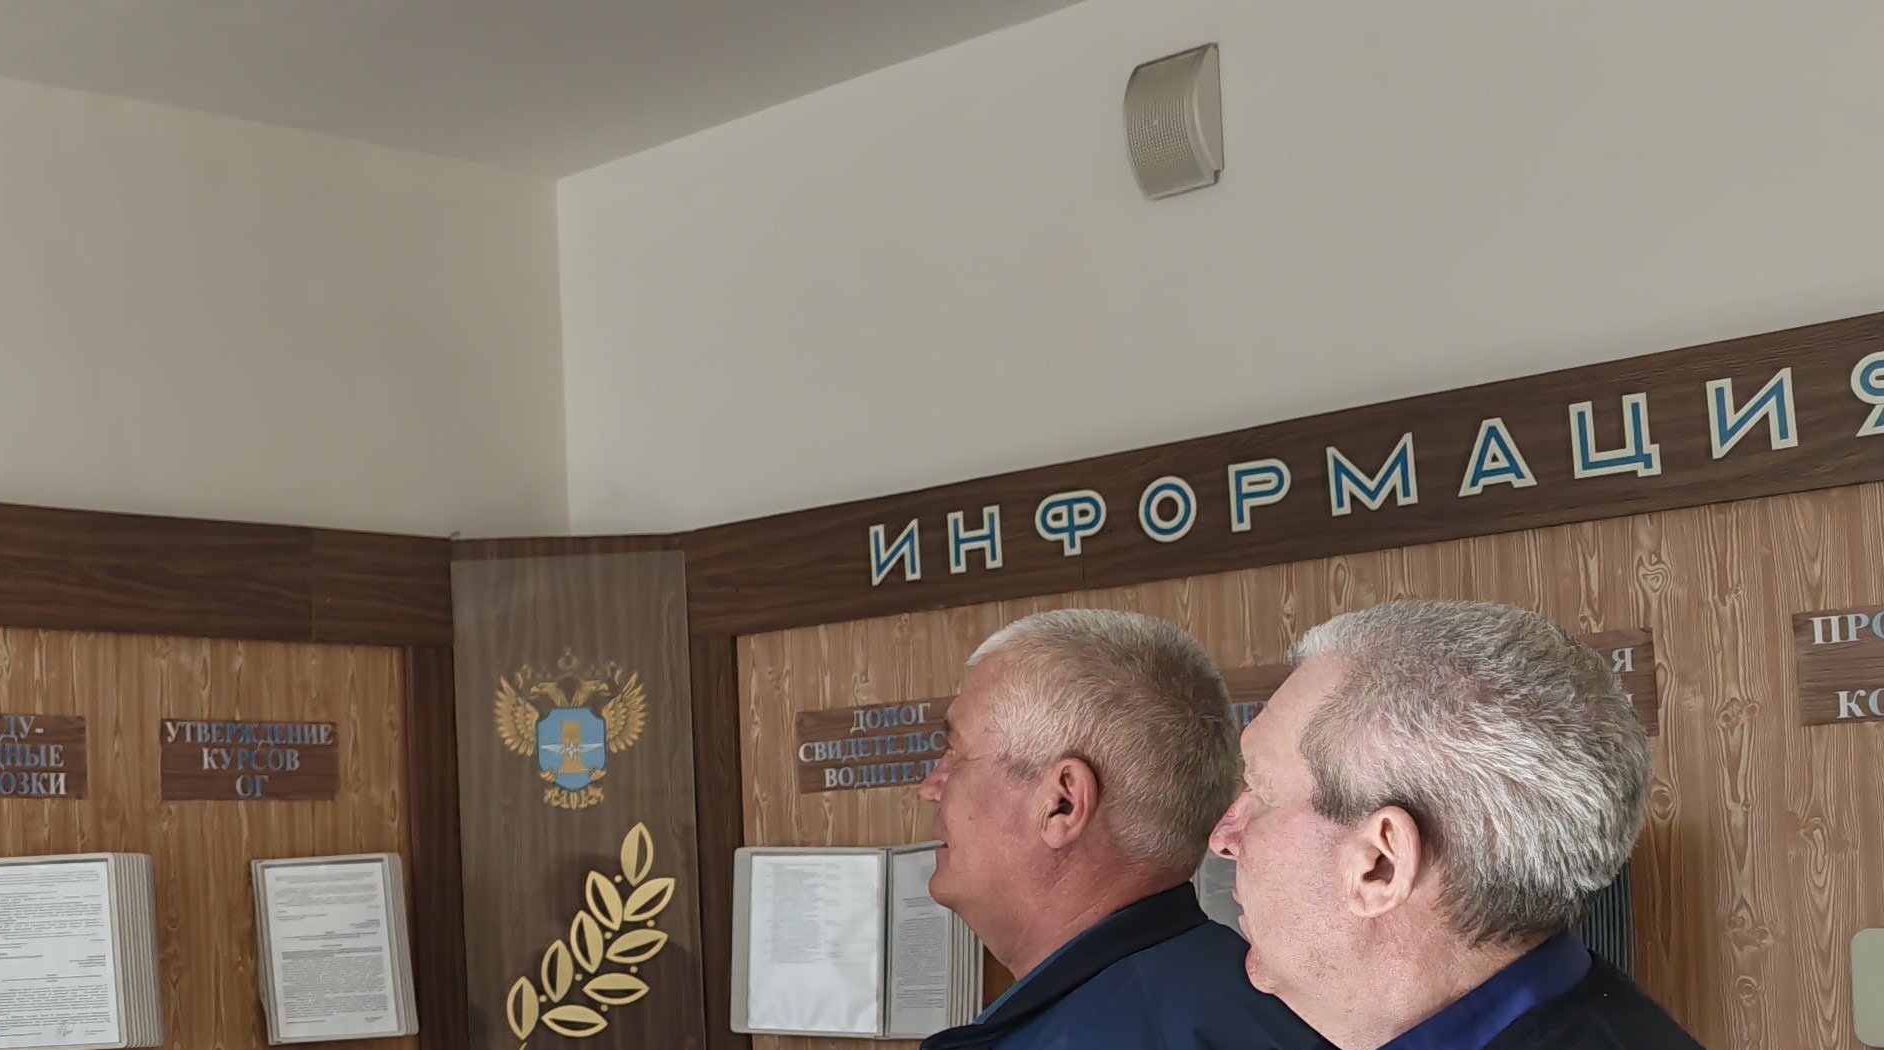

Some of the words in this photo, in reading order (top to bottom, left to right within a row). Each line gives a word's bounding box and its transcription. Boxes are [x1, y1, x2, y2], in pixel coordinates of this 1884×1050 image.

[850, 703, 931, 735] ДОПОГ
[164, 721, 334, 748] УТВЕРЖДЕНИЕ
[202, 747, 300, 771] КУРСОВ
[235, 775, 269, 797] ОГ
